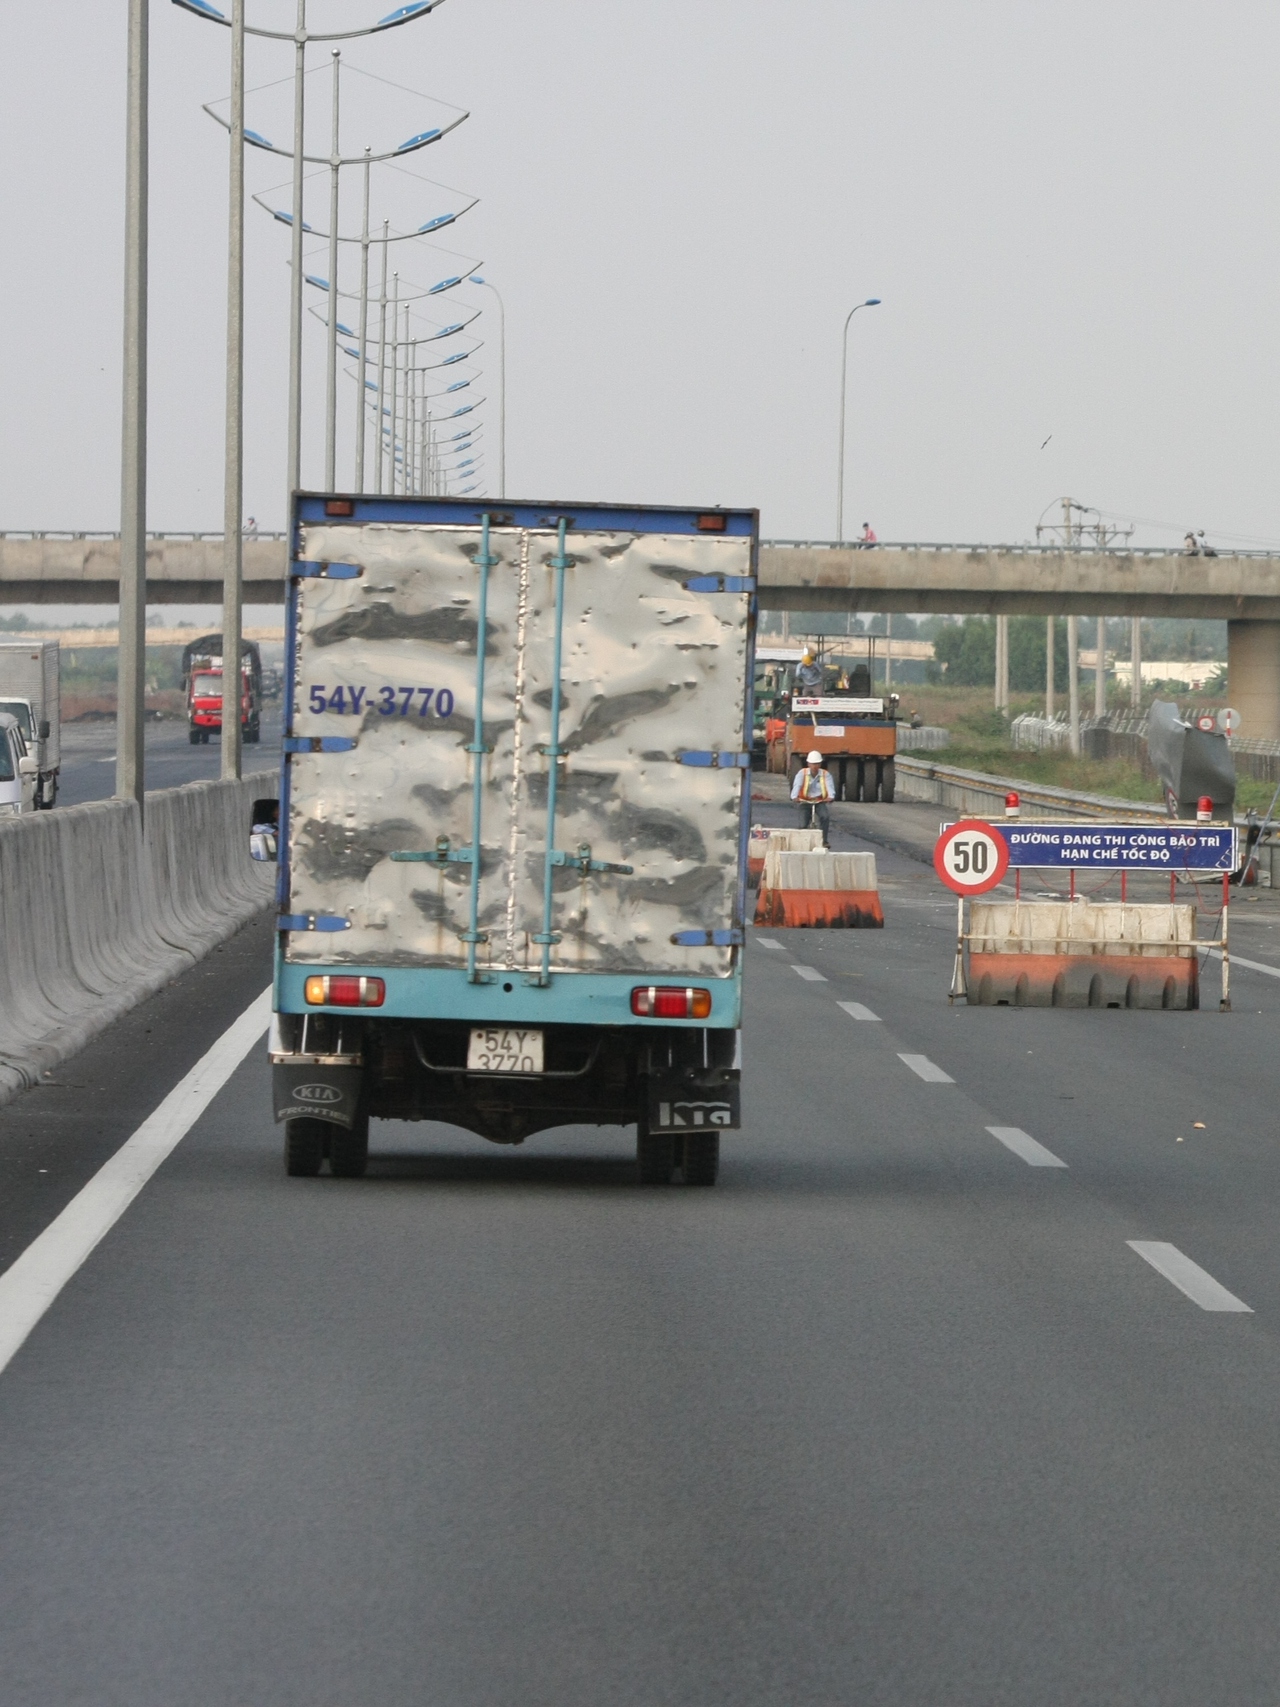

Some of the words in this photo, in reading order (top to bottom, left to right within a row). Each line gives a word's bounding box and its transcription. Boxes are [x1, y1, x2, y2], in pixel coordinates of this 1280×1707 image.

[308, 684, 454, 718] 54Y-3770
[1010, 832, 1060, 844] ĐƯỜNG
[1063, 834, 1101, 845] ĐANG
[1104, 835, 1126, 845] THI
[1129, 834, 1166, 846] CÔNG
[1169, 834, 1197, 847] BẢO
[1199, 835, 1220, 847] TRÌ
[953, 841, 988, 874] 50
[1061, 848, 1089, 861] HẠN
[1092, 847, 1119, 859] CHẾ
[1121, 847, 1147, 860] TỐC
[1150, 848, 1170, 862] ĐỘ
[485, 1030, 527, 1053] 54Y
[478, 1053, 534, 1072] 3770
[300, 1087, 334, 1100] KIA
